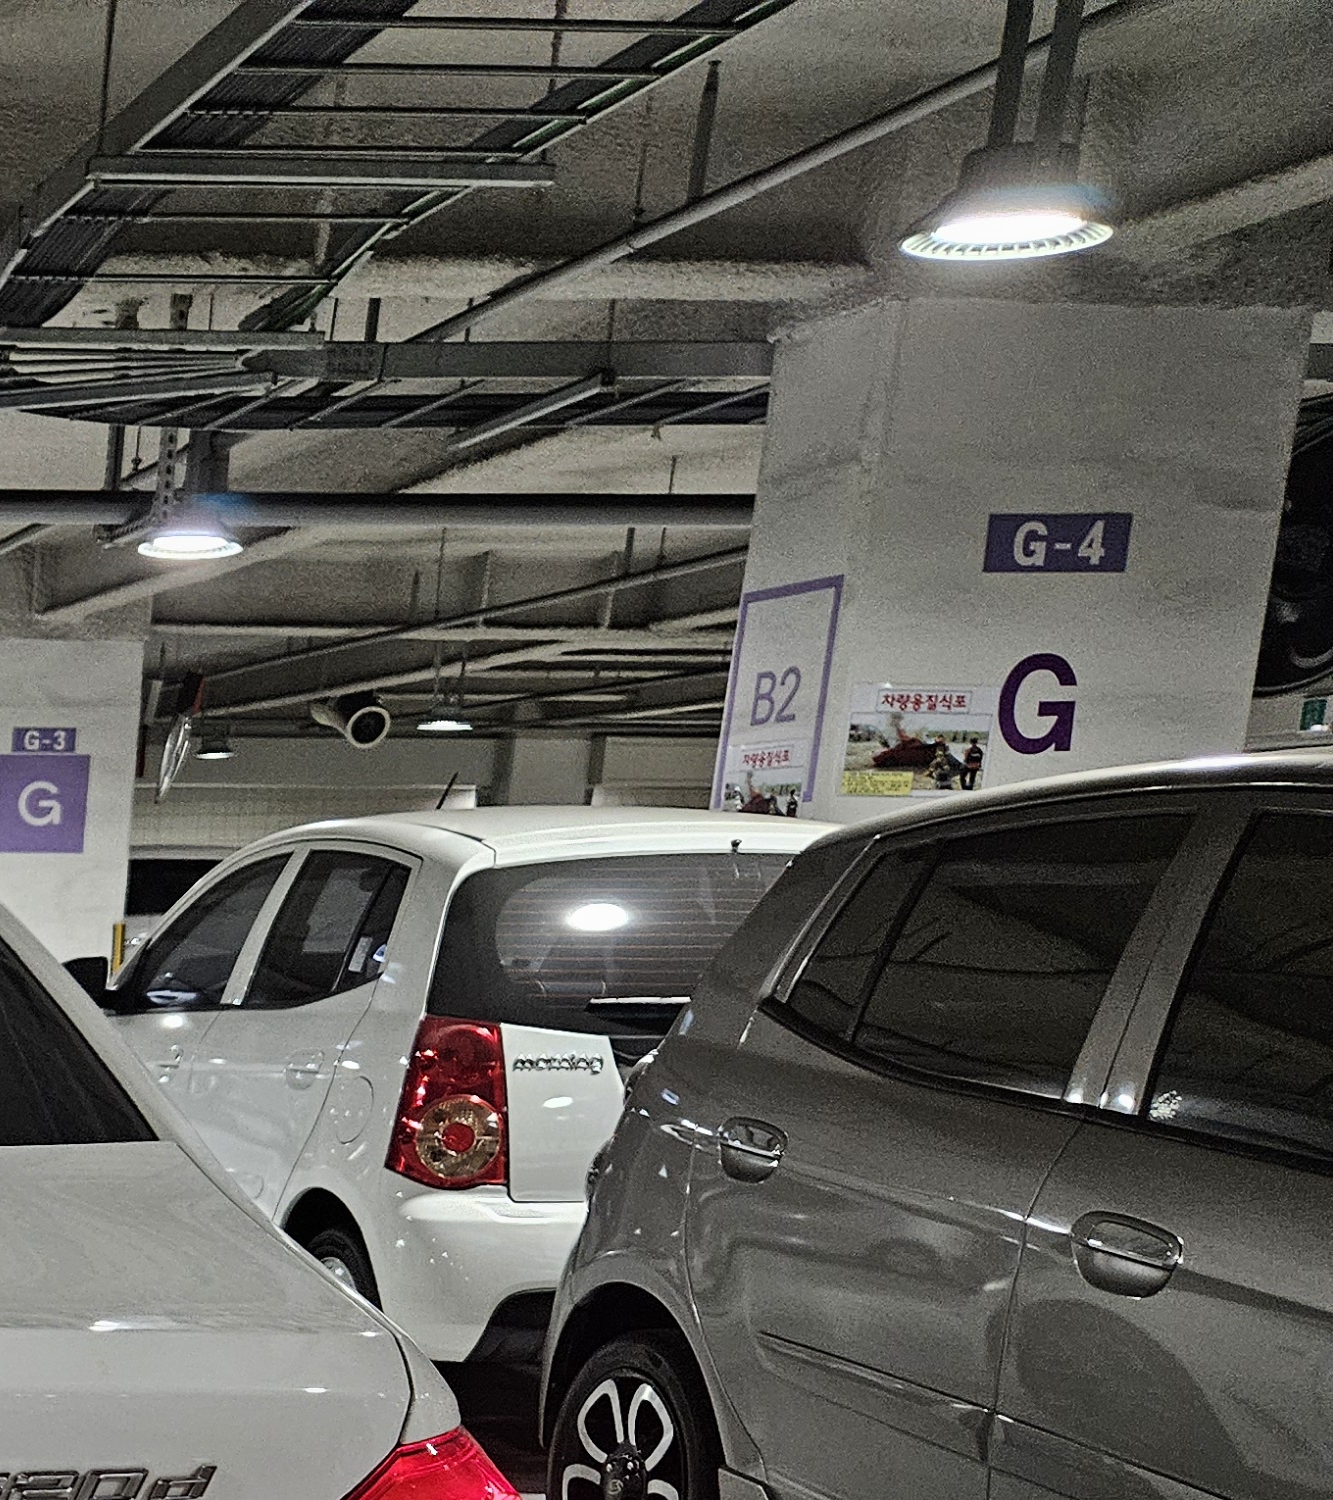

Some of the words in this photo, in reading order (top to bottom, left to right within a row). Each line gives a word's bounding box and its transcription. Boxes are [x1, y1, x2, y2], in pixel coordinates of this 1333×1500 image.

[1013, 519, 1106, 567] G-4
[750, 666, 802, 727] B2
[997, 652, 1078, 755] G
[23, 730, 67, 751] G-3
[17, 780, 62, 827] G
